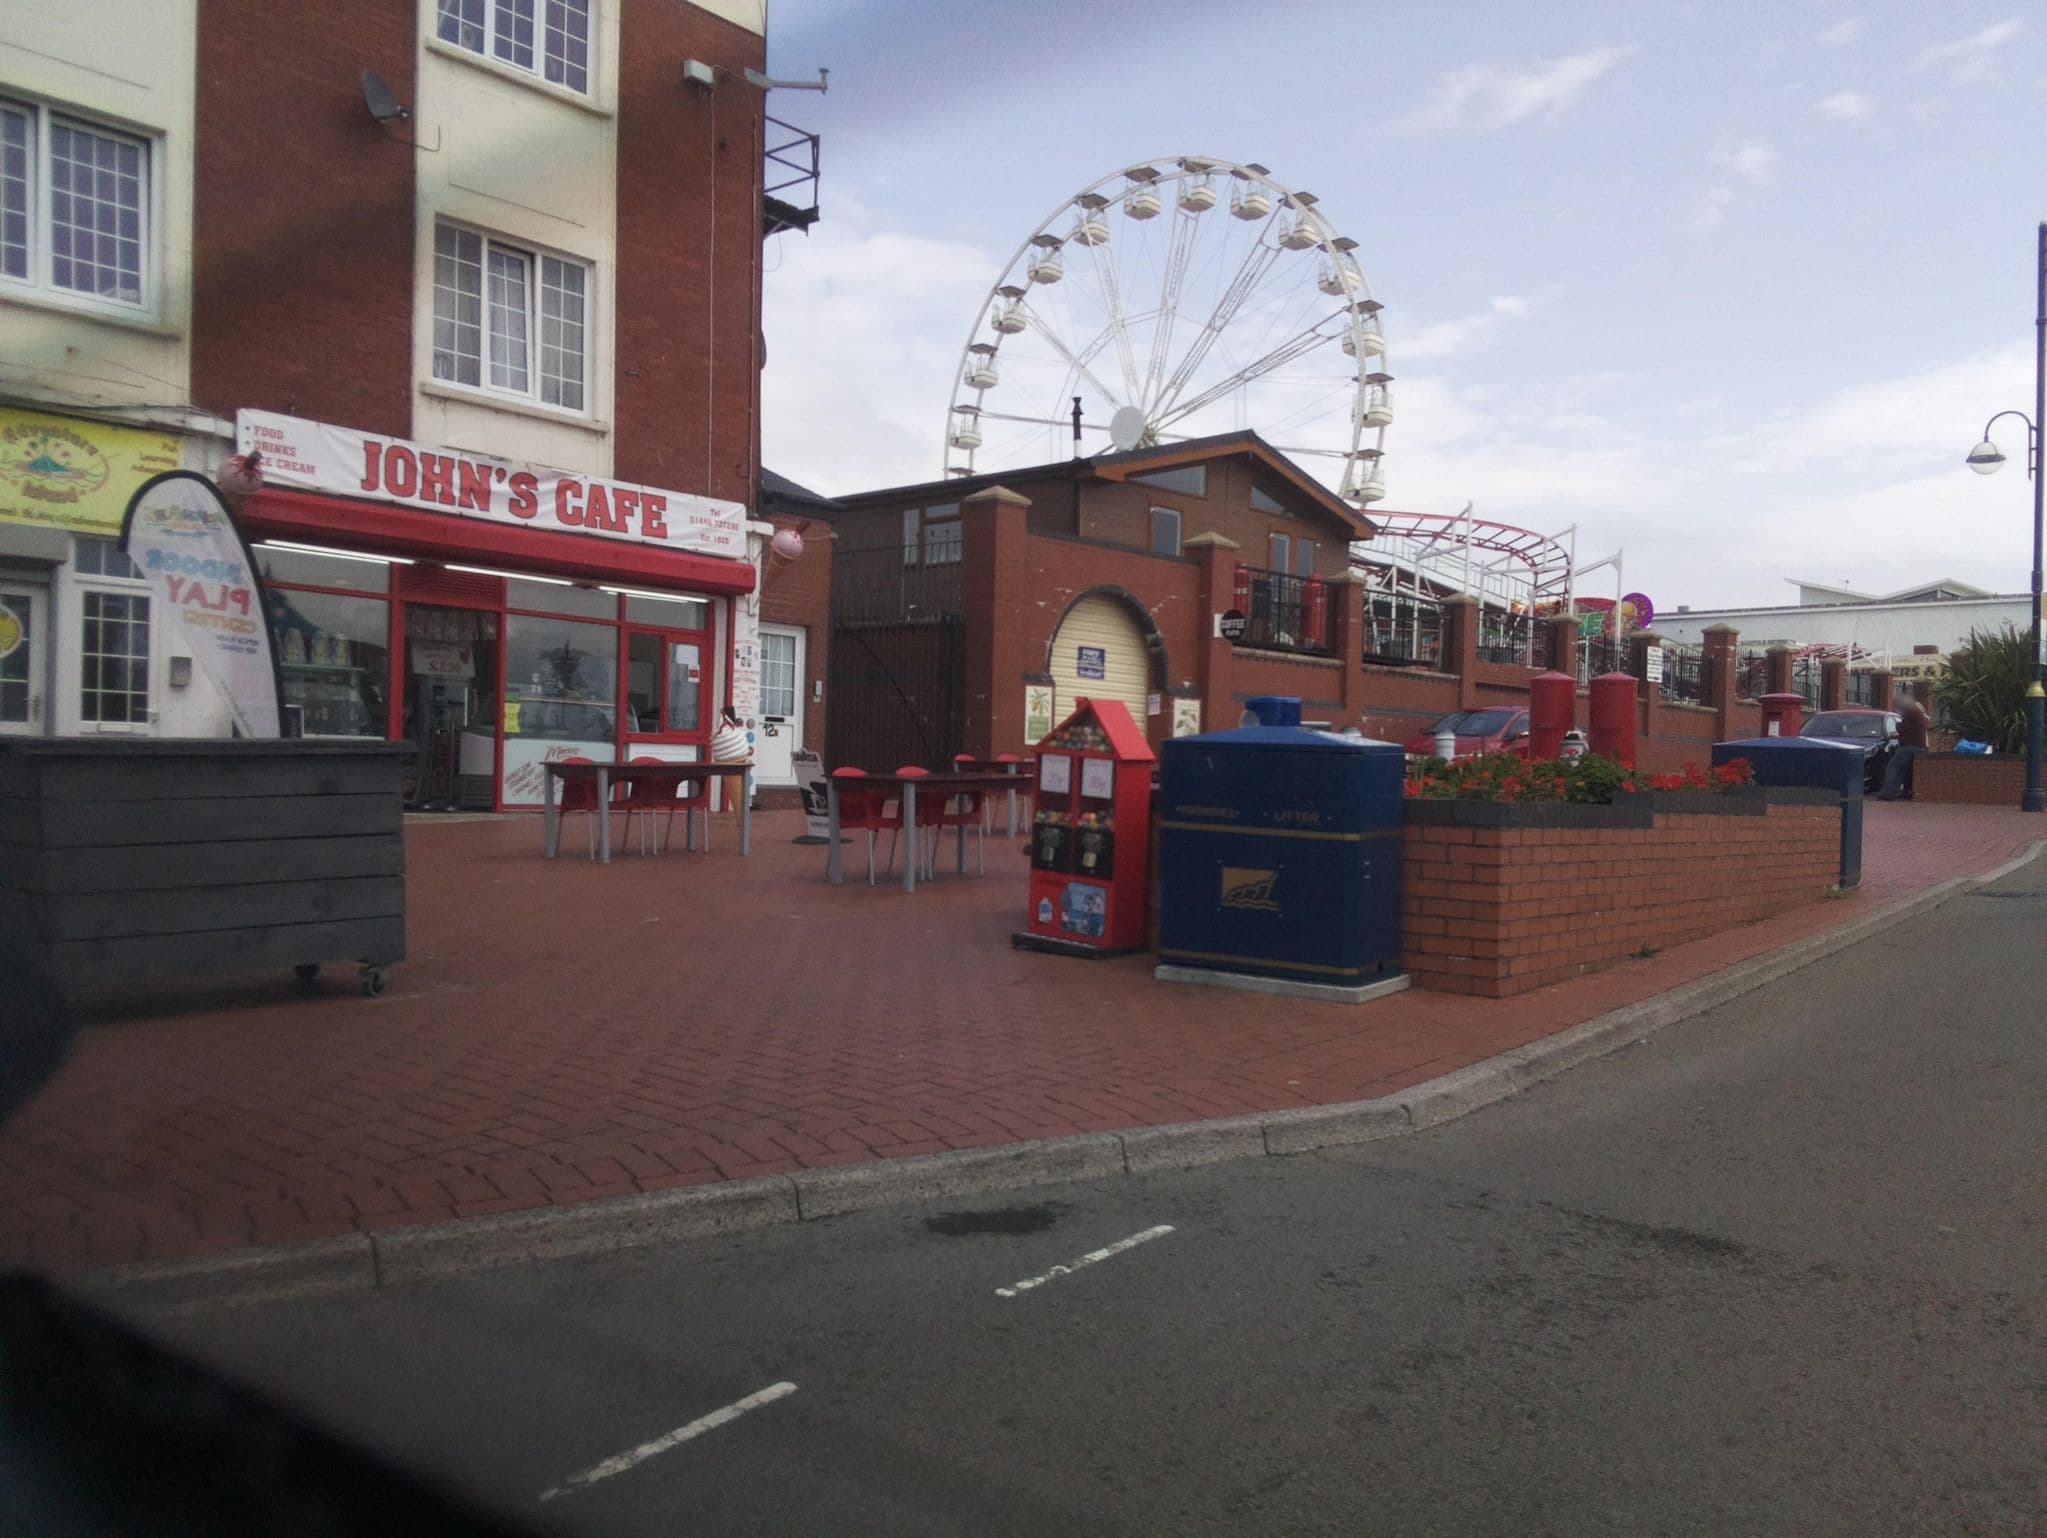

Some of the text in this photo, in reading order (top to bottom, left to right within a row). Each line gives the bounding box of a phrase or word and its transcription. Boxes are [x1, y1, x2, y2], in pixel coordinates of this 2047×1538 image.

[254, 425, 284, 440] FOOD
[254, 440, 297, 457] DRINKS
[277, 459, 315, 474] CREAM
[361, 440, 667, 539] JOHN'S CAFE
